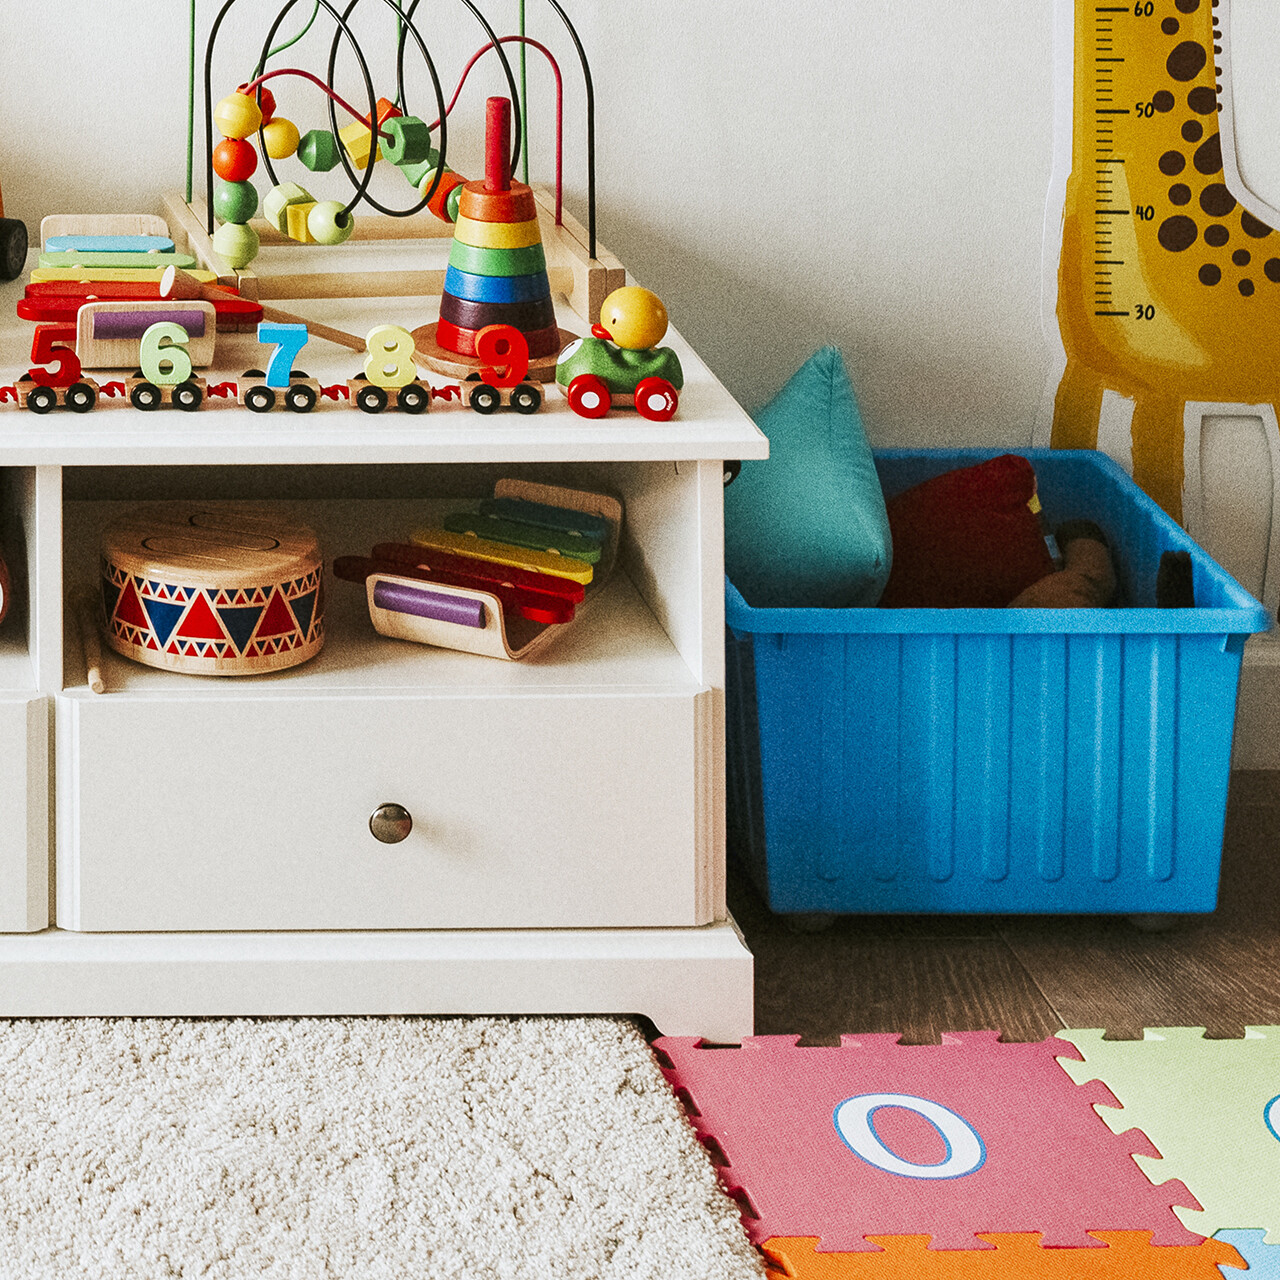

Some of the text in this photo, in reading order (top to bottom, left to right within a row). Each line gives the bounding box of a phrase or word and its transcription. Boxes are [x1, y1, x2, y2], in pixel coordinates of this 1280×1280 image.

[1135, 1, 1154, 16] 60
[1136, 101, 1155, 118] 50
[1136, 206, 1154, 220] 40
[1135, 305, 1155, 320] 30
[30, 324, 81, 389] 5
[139, 321, 192, 386] 6
[256, 323, 309, 388] 7
[364, 321, 416, 389] 8
[474, 324, 531, 390] 9
